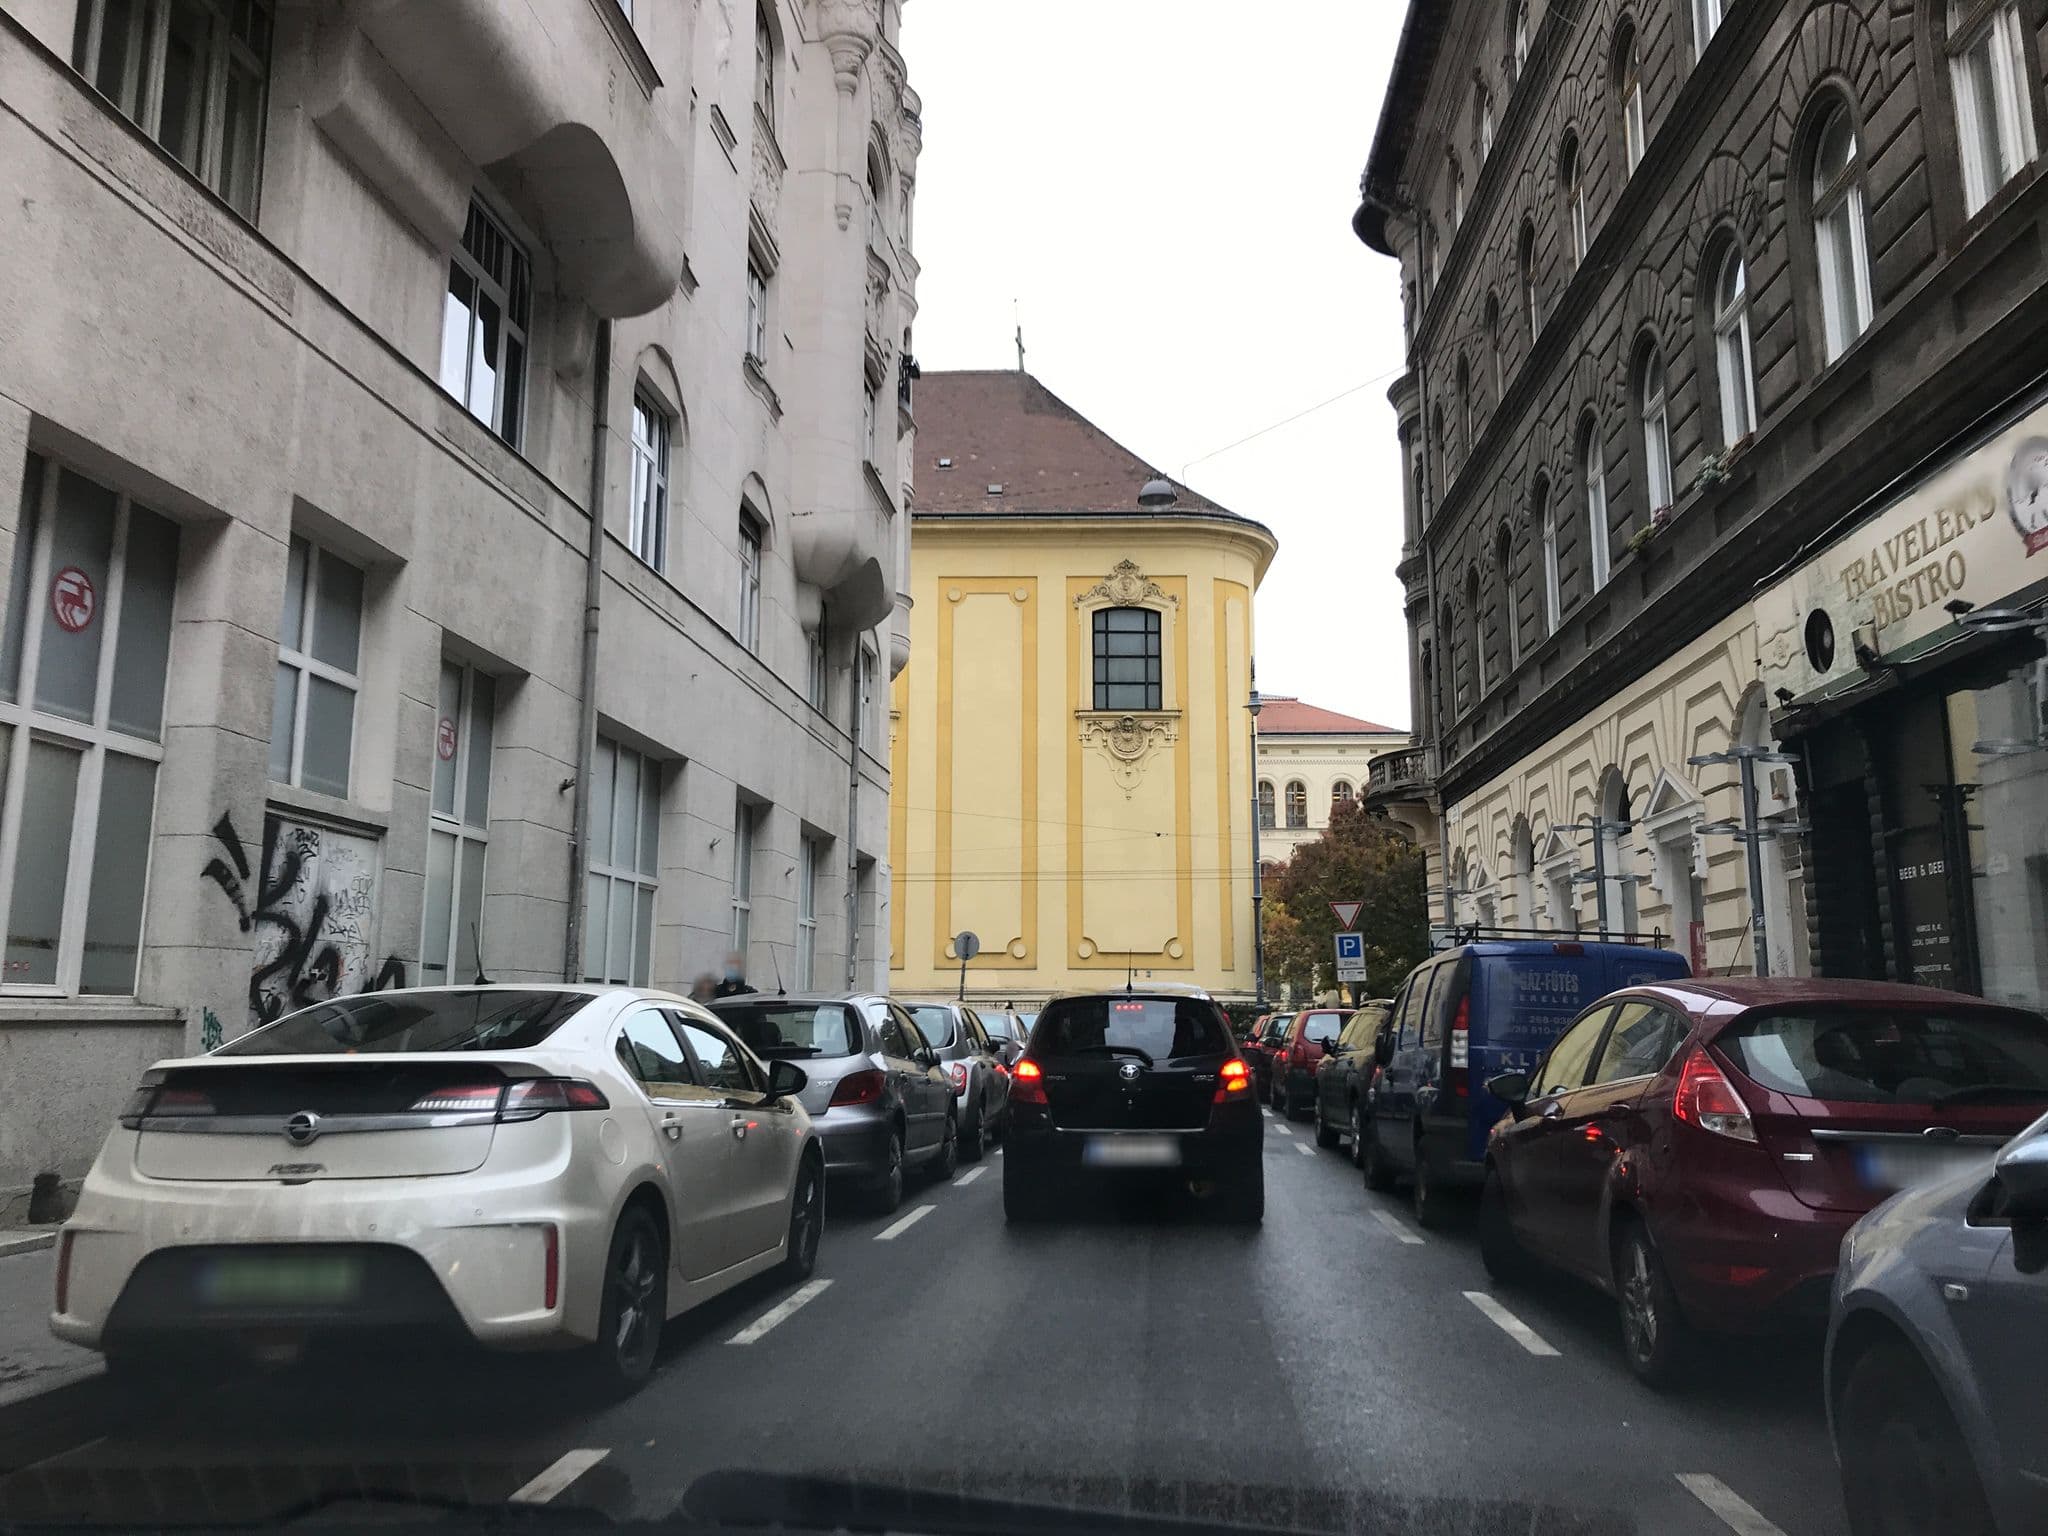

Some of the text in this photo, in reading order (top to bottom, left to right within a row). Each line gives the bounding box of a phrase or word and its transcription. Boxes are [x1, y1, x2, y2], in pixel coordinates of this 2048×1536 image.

[1873, 549, 1966, 632] BISTRO
[1899, 866, 1917, 880] BEER
[1343, 939, 1355, 955] P
